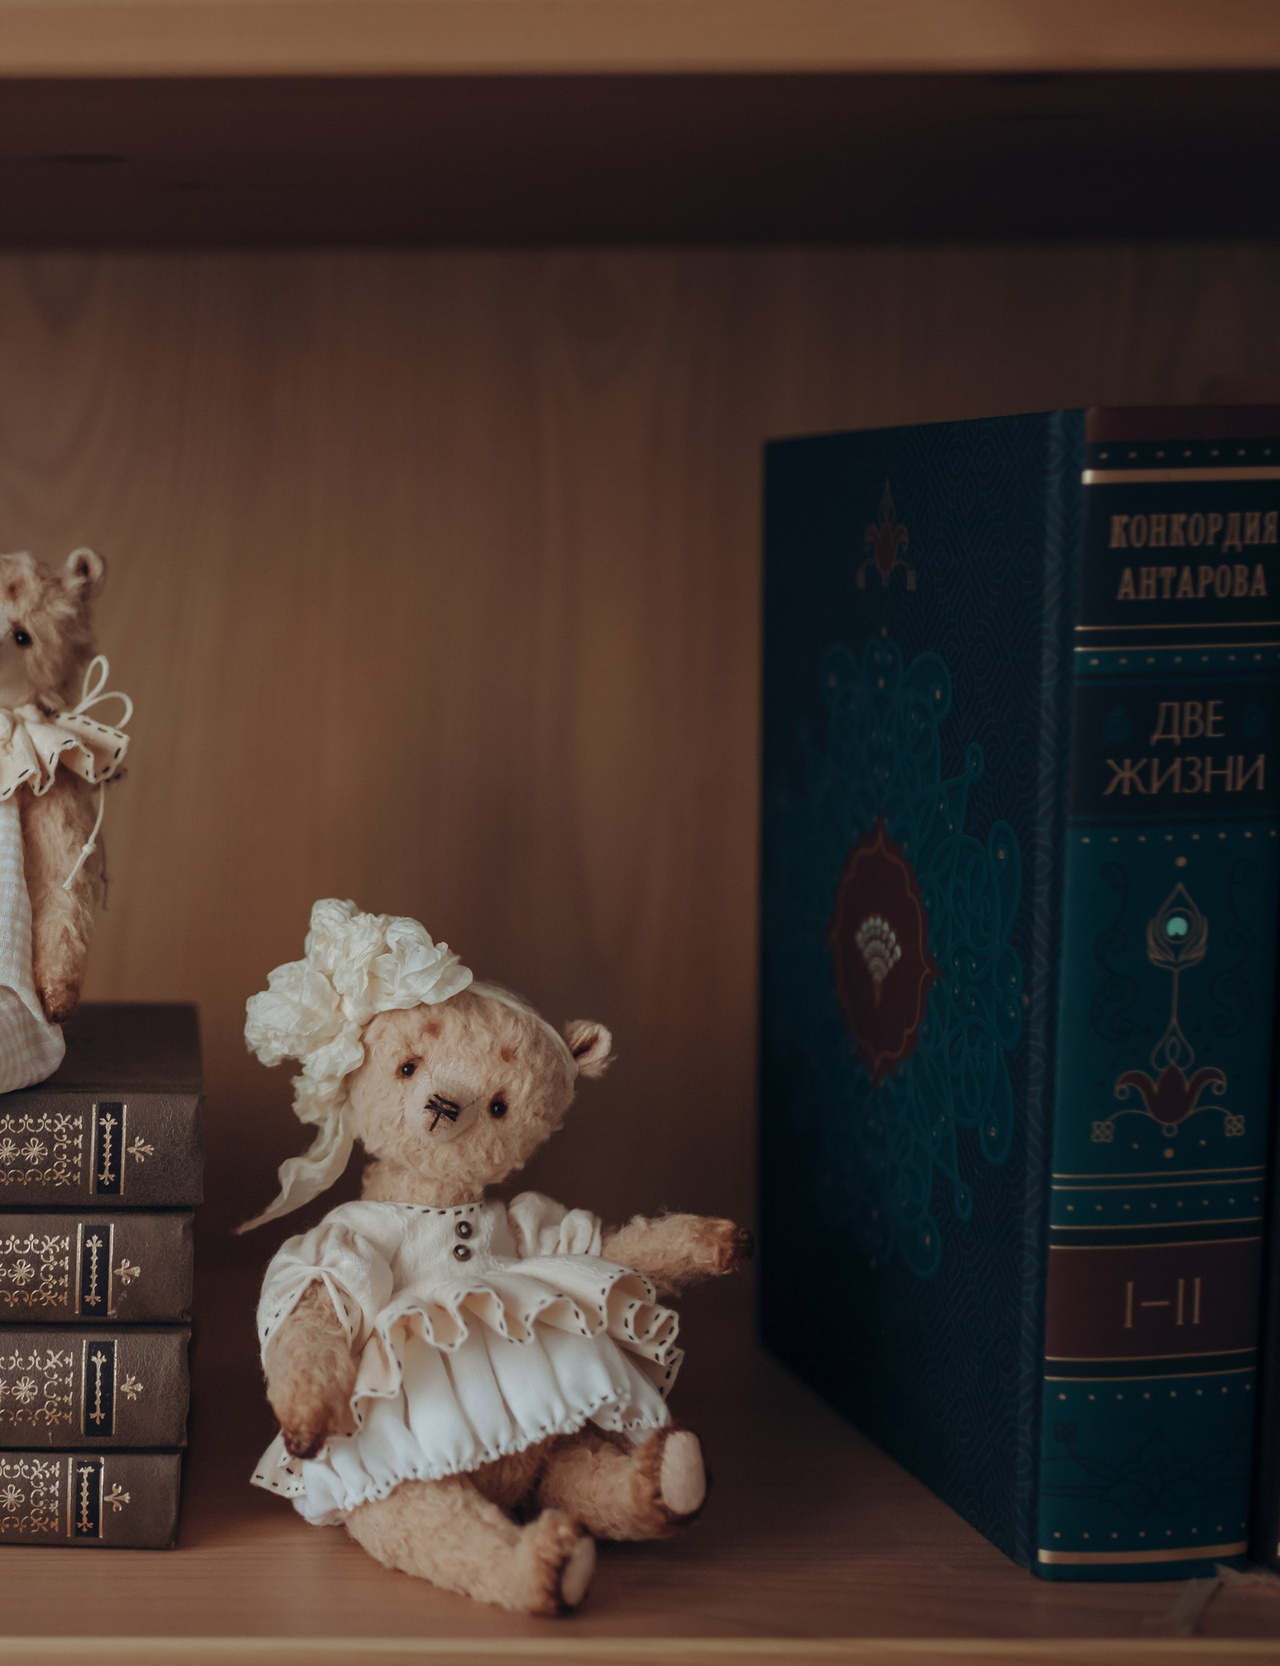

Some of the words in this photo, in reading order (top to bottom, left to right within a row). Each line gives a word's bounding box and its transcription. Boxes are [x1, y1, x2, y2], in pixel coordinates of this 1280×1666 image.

[1109, 510, 1279, 553] КОНКОРДИЯ
[1117, 563, 1269, 600] АНТАРОВА
[1149, 700, 1226, 746] ДВЕ
[1102, 754, 1266, 796] ЖИЗНИ
